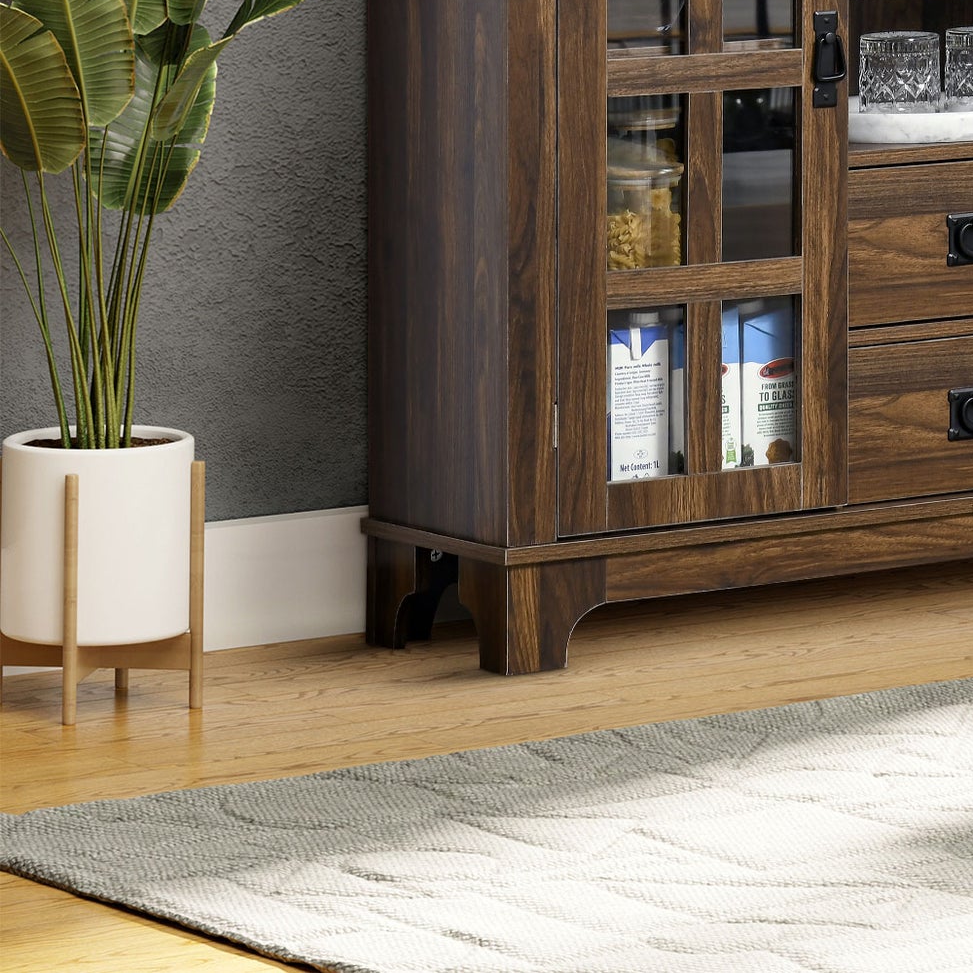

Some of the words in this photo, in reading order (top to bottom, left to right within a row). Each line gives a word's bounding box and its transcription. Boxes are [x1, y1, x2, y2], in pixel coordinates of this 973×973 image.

[761, 382, 777, 391] FROM
[759, 391, 770, 402] TO
[620, 463, 630, 472] Net
[630, 462, 653, 471] Content:
[653, 460, 659, 469] 1L
